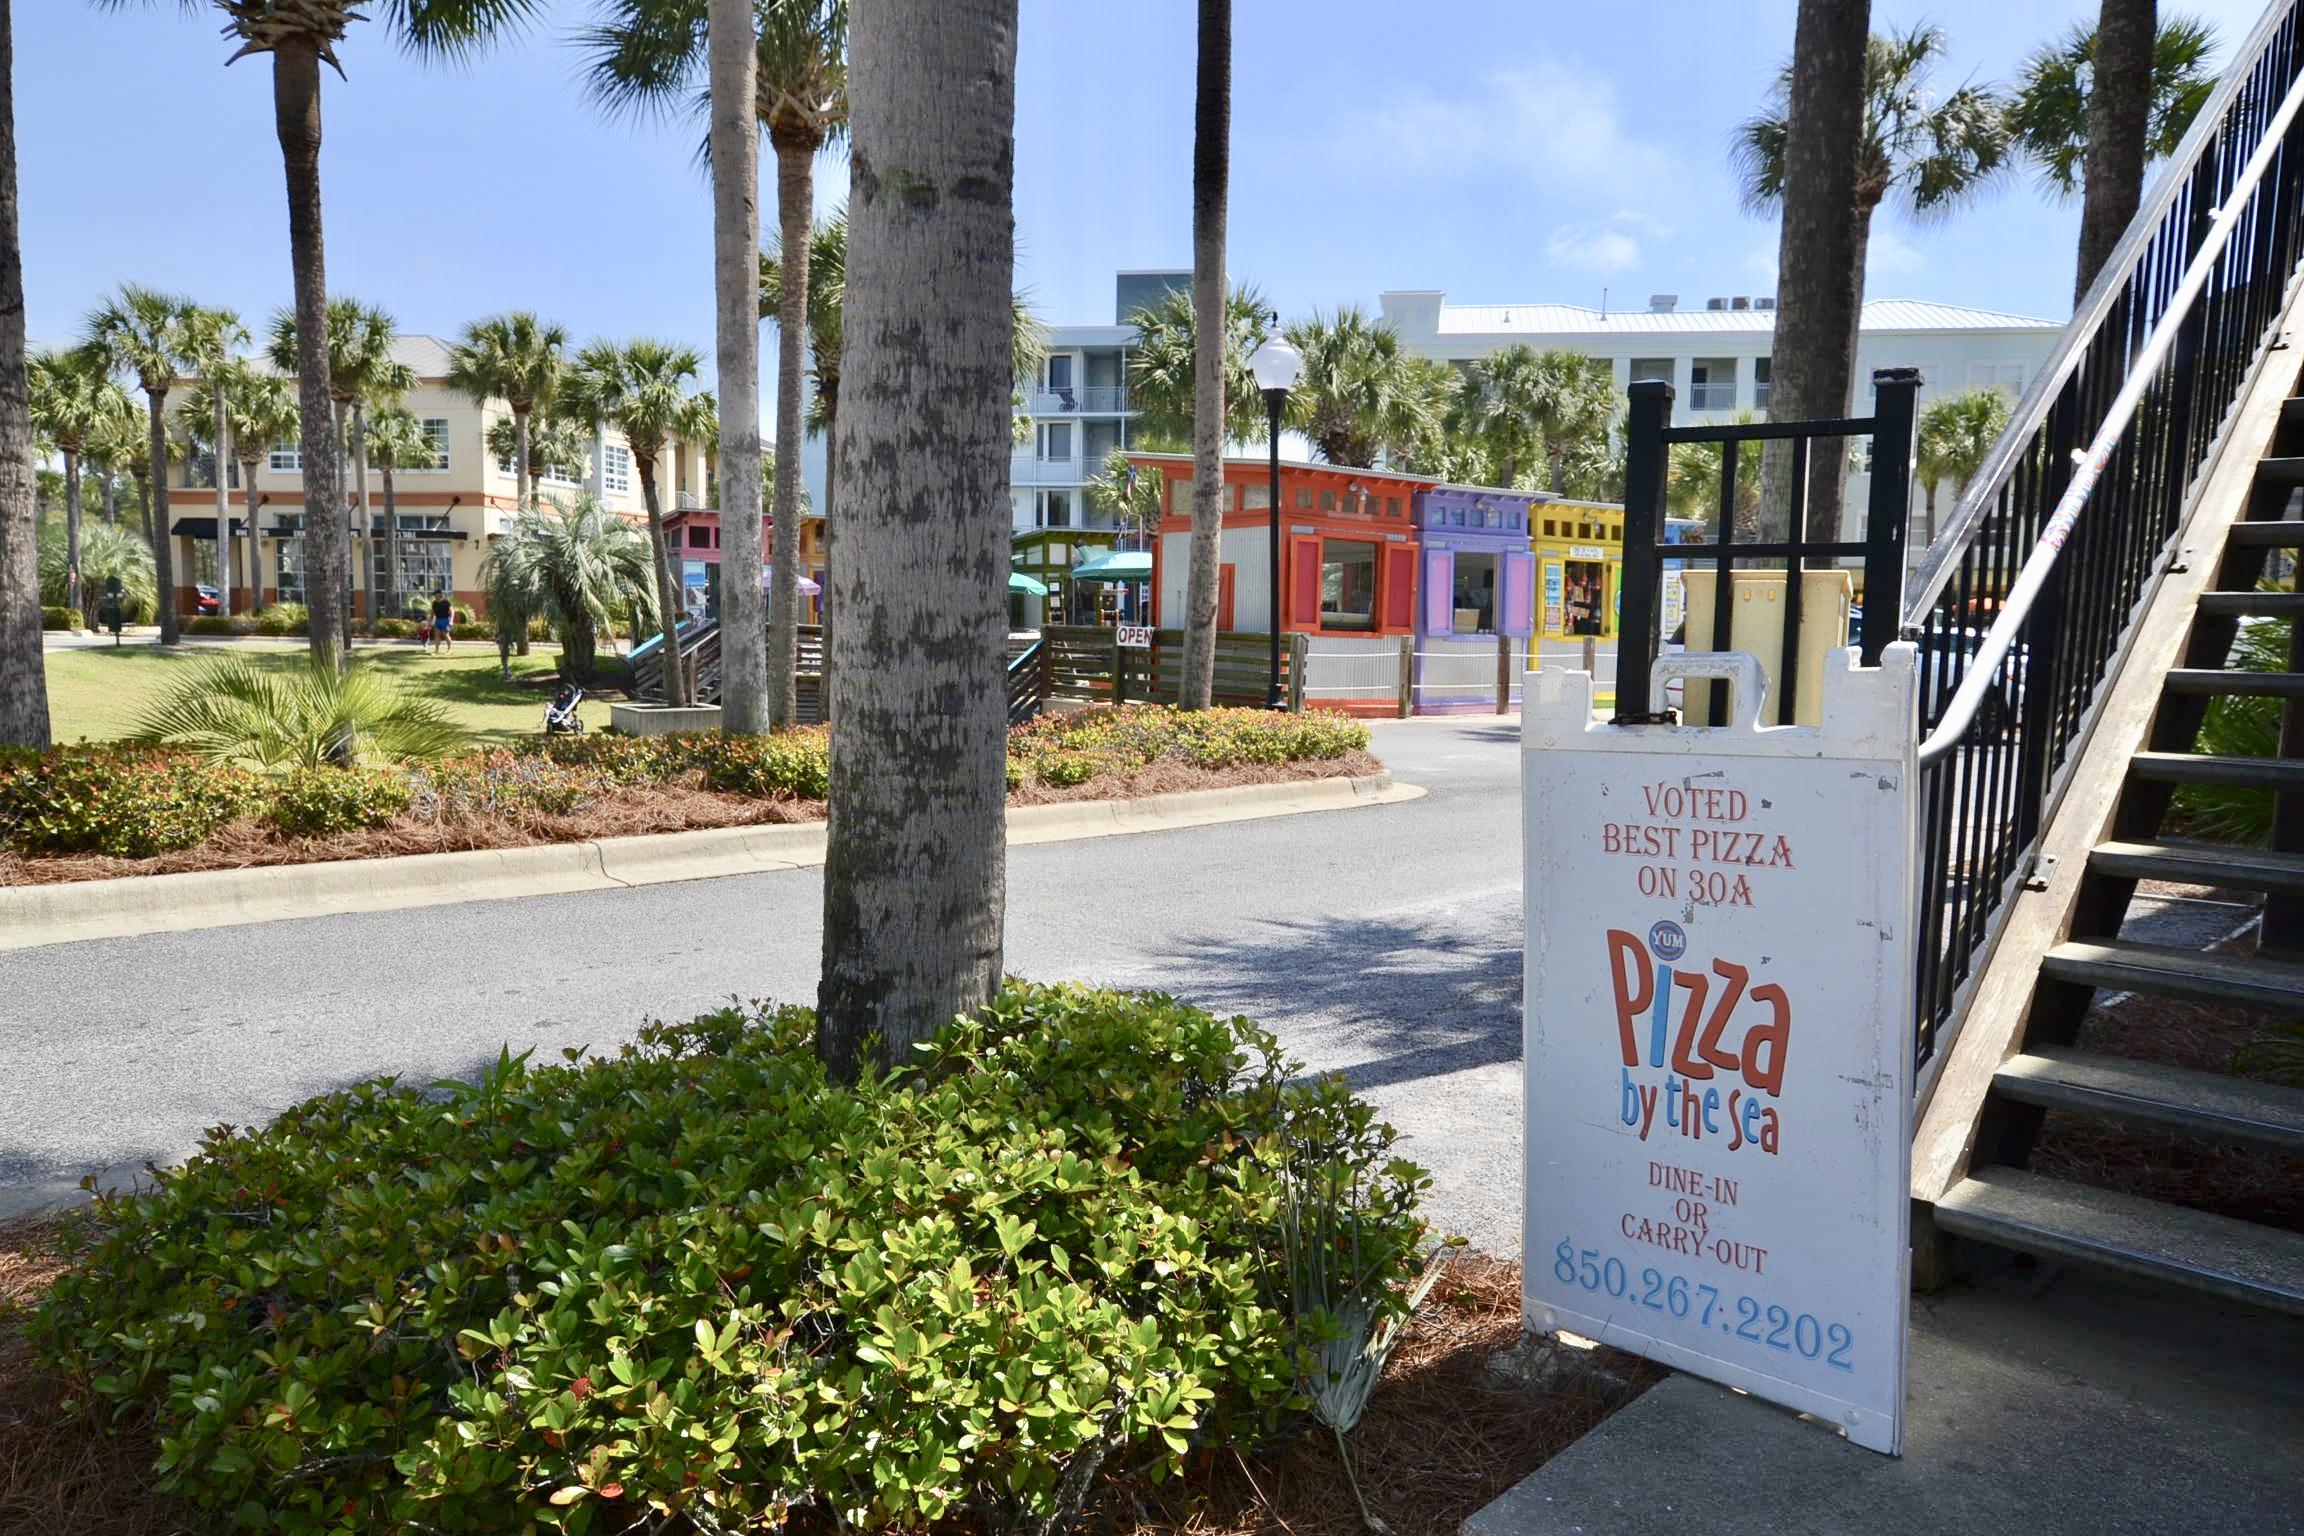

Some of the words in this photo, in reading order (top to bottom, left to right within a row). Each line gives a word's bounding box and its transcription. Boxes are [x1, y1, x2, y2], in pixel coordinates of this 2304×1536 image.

[1119, 628, 1152, 643] OPEN
[1642, 780, 1748, 822] VOTED
[1603, 823, 1680, 857] BEST
[1690, 829, 1796, 868] PIZZA
[1638, 865, 1677, 898] ON
[1689, 869, 1754, 906] 30A
[1654, 929, 1683, 948] YUM
[1606, 928, 1791, 1098] Pizza
[1621, 1067, 1657, 1142] by
[1665, 1074, 1720, 1140] the
[1649, 1161, 1739, 1206] DINE-IN
[1675, 1198, 1709, 1230] OR
[1621, 1213, 1768, 1275] CARRY-OUT
[1554, 1236, 1854, 1371] 850.267.2202
